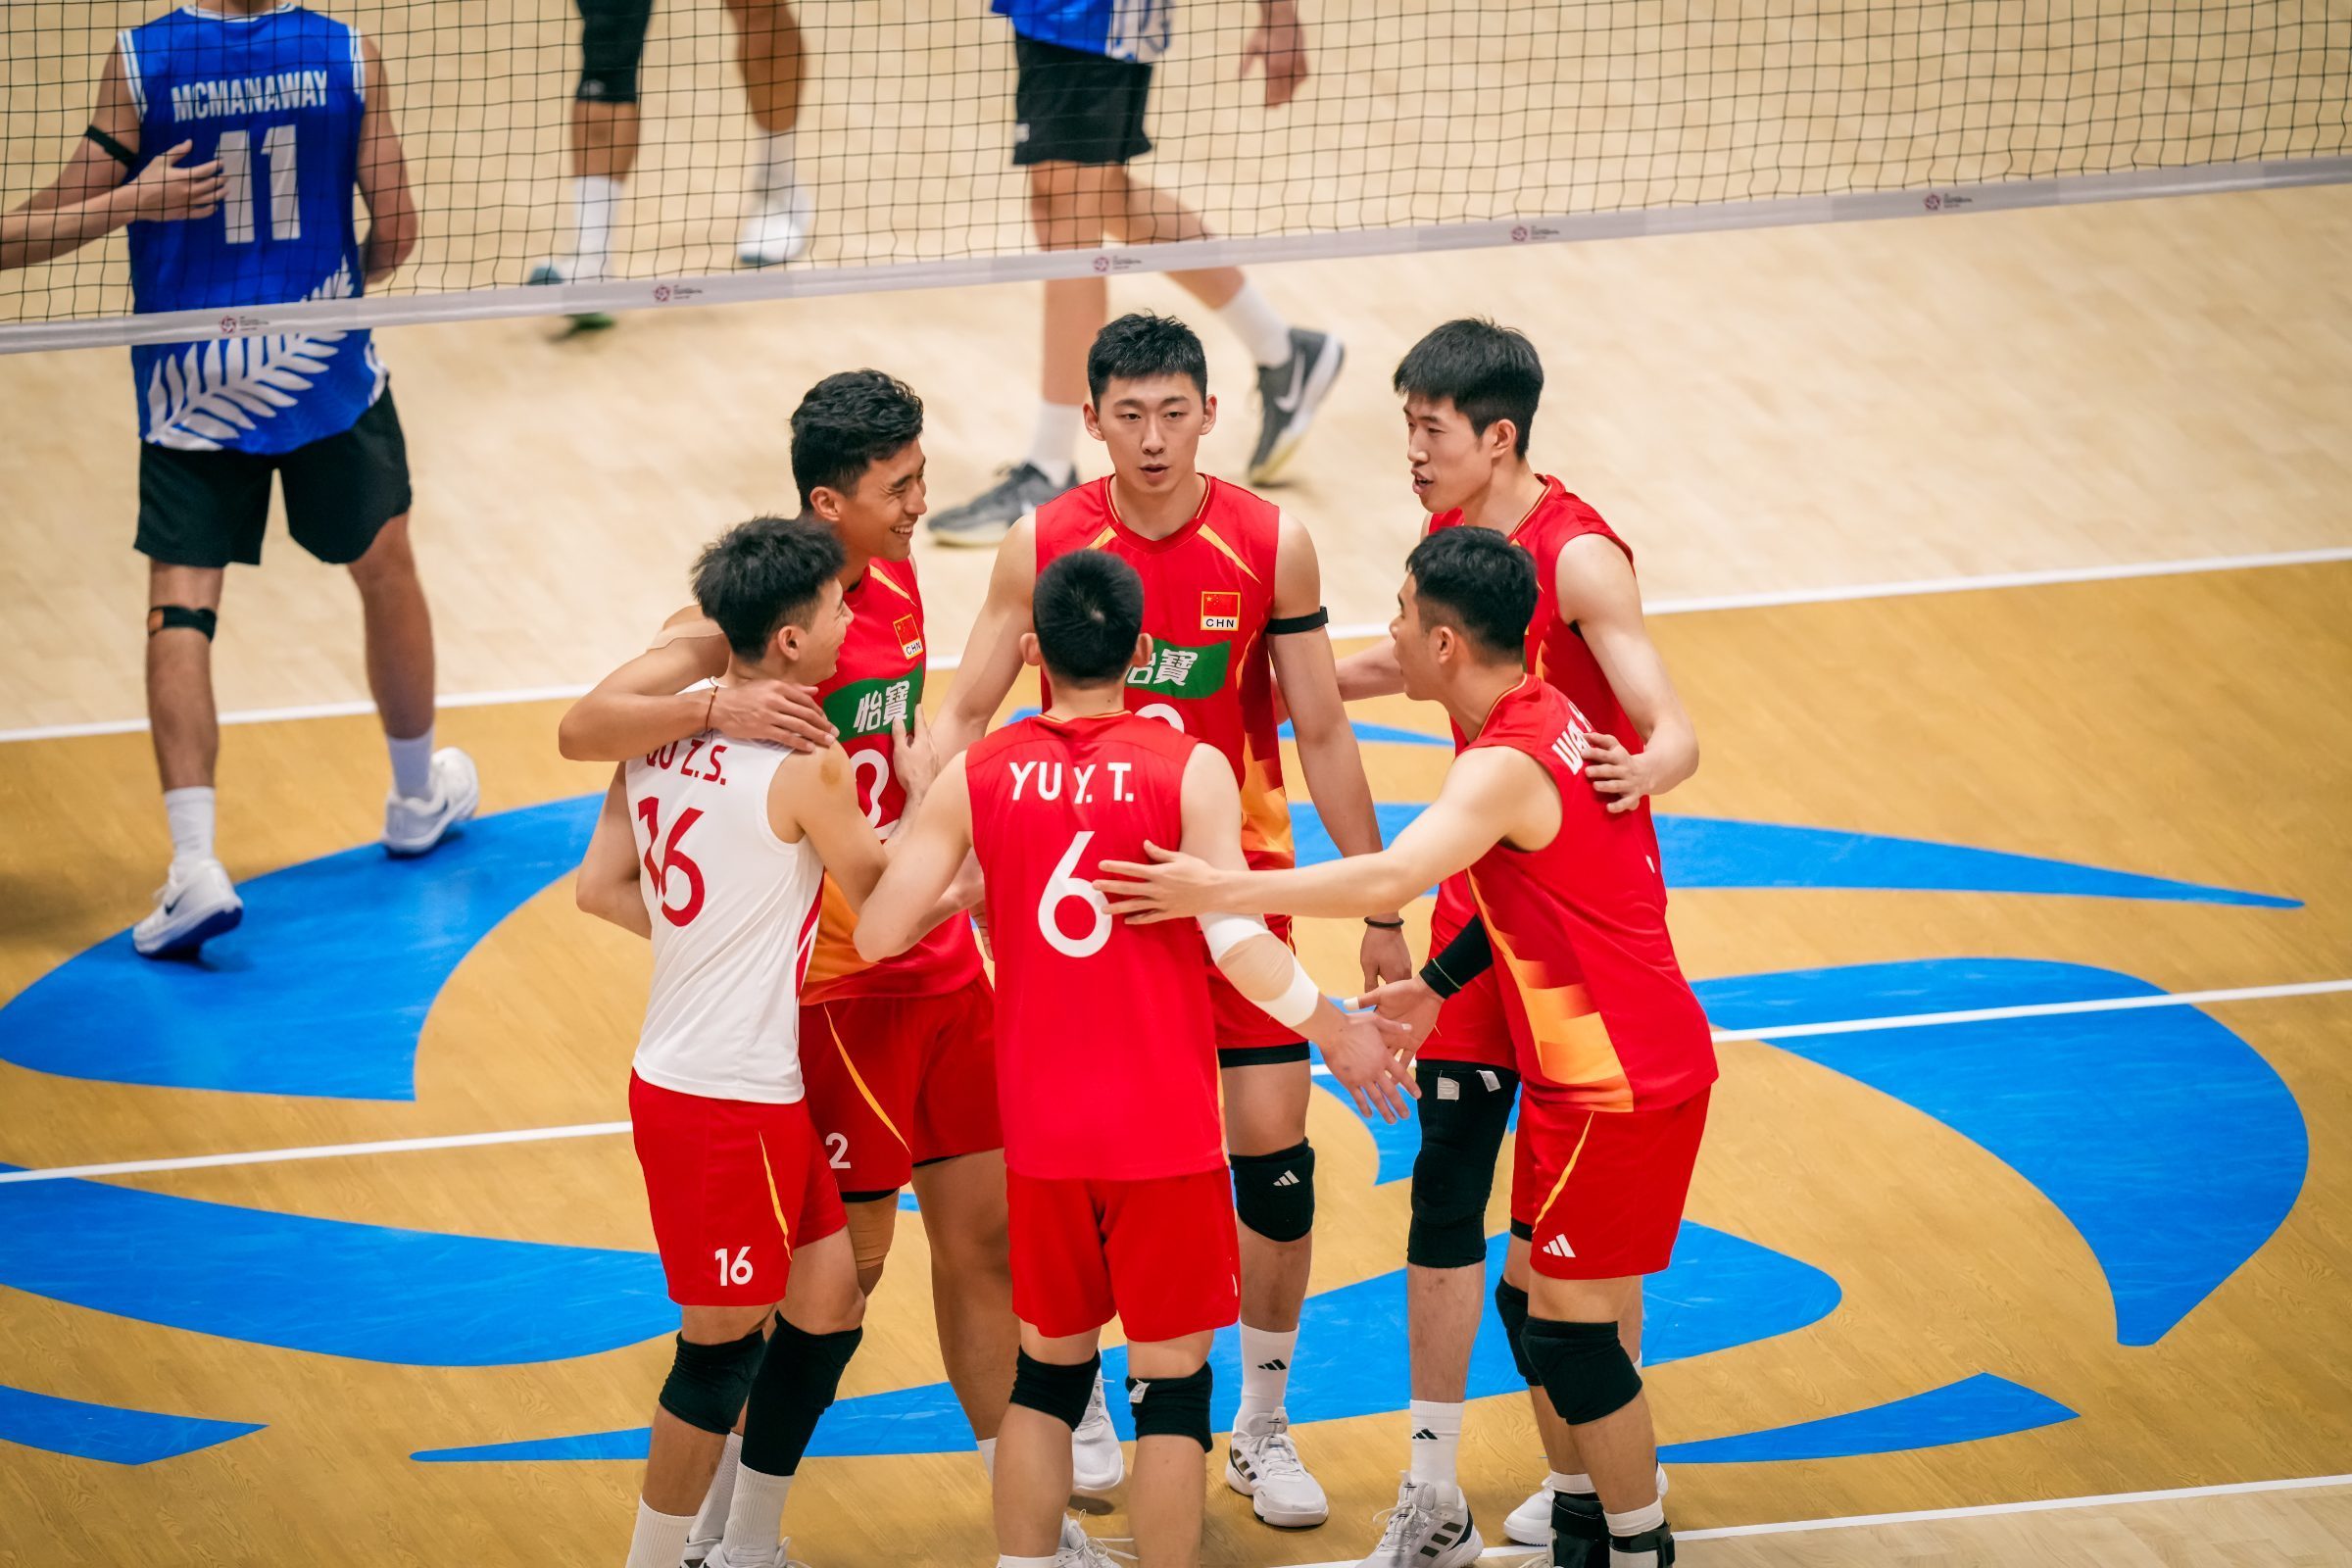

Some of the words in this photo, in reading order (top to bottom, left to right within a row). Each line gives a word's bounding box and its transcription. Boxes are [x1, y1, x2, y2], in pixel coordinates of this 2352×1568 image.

[171, 71, 327, 122] MCMANAWAY
[214, 124, 301, 244] 11
[1205, 618, 1234, 628] CHN
[906, 641, 921, 656] CHN
[854, 680, 910, 733] 怡寶
[1008, 760, 1062, 801] YU
[638, 796, 705, 927] 16
[1037, 831, 1113, 957] 6
[825, 1132, 852, 1169] 2
[714, 1246, 754, 1286] 16
